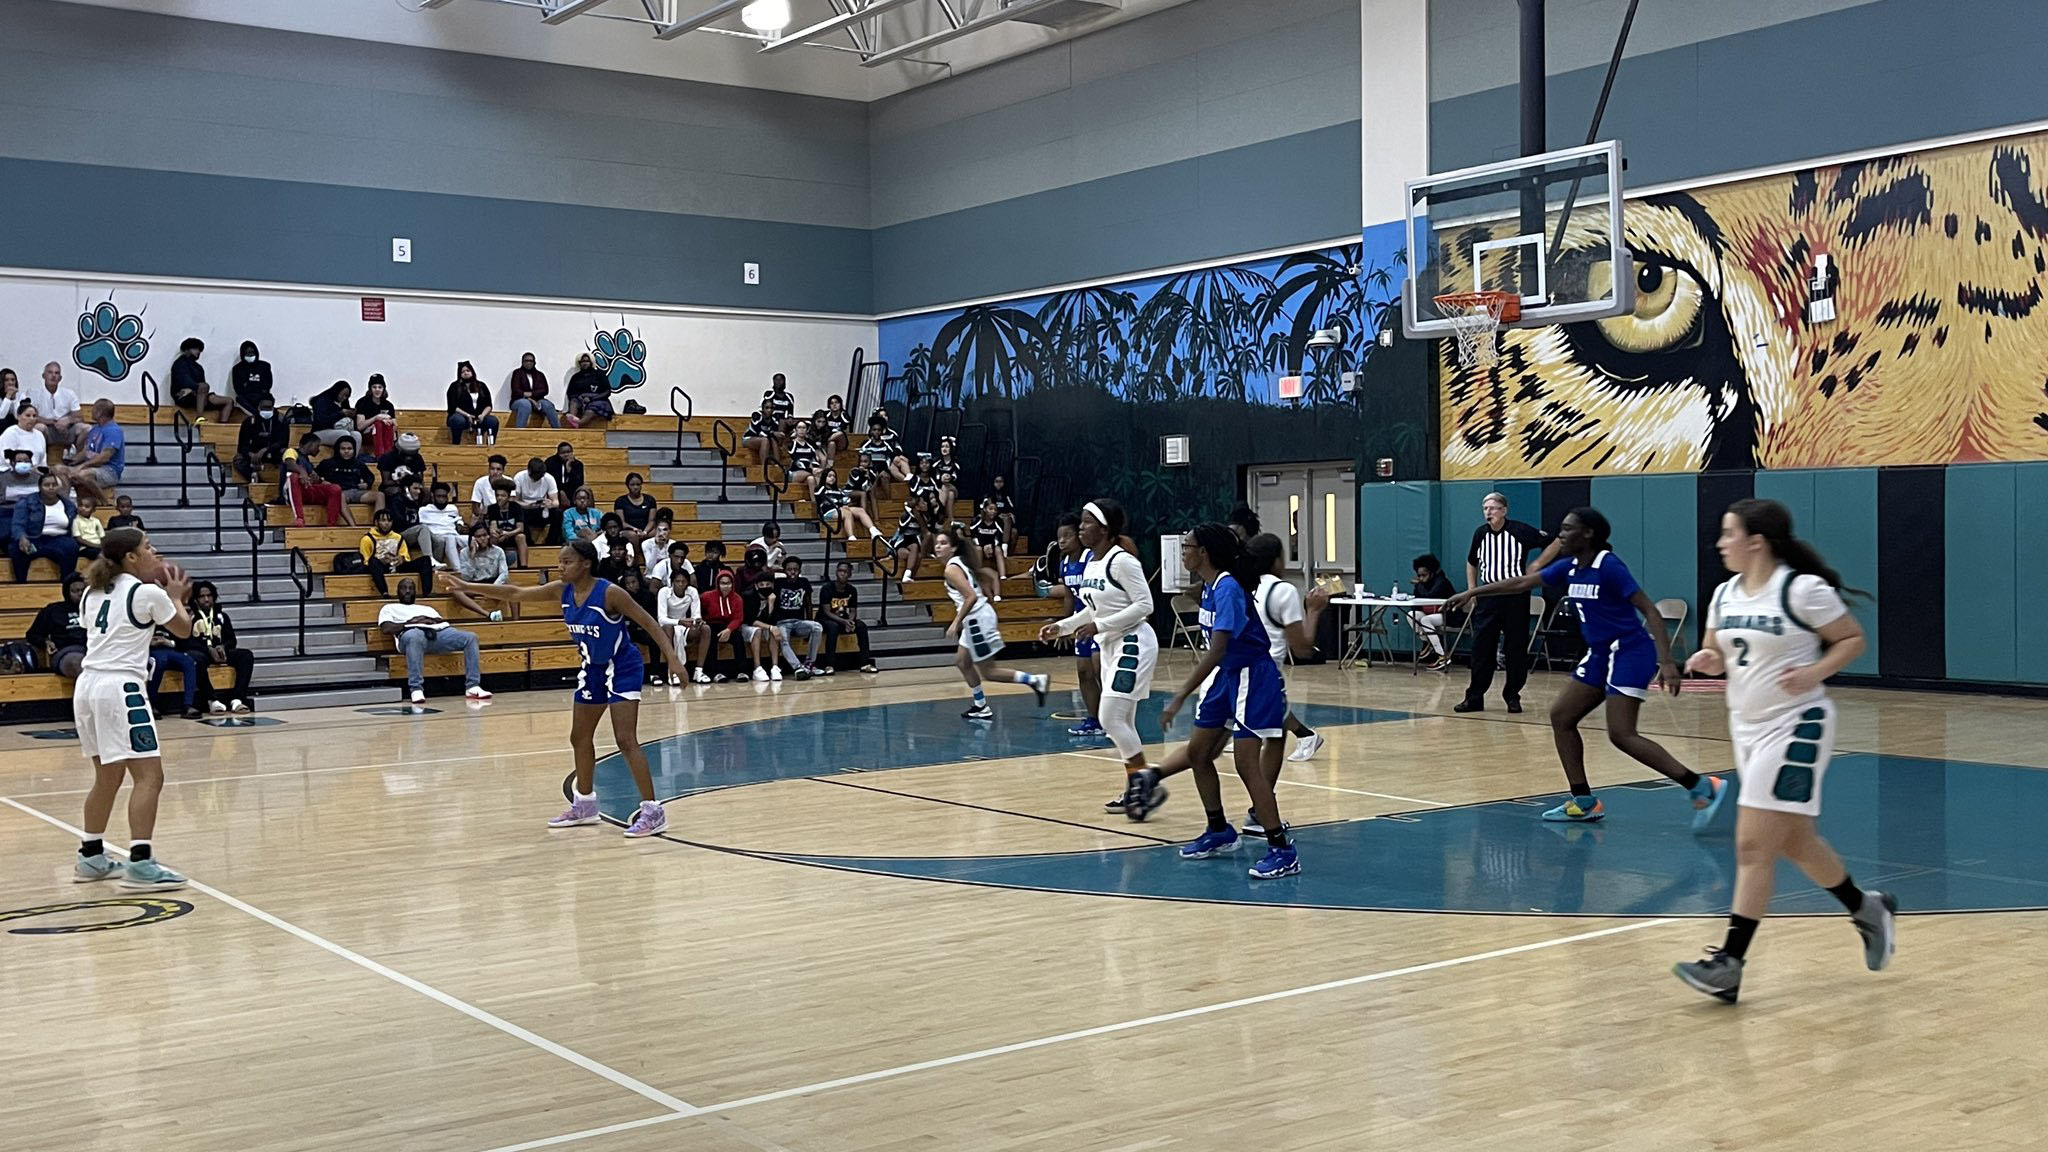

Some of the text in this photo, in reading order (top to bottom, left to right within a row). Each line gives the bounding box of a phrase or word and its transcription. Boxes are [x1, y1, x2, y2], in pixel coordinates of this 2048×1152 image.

[398, 245, 406, 257] 5
[748, 269, 755, 280] 6
[1083, 593, 1097, 612] 11
[94, 599, 111, 634] 4
[1731, 637, 1750, 667] 2
